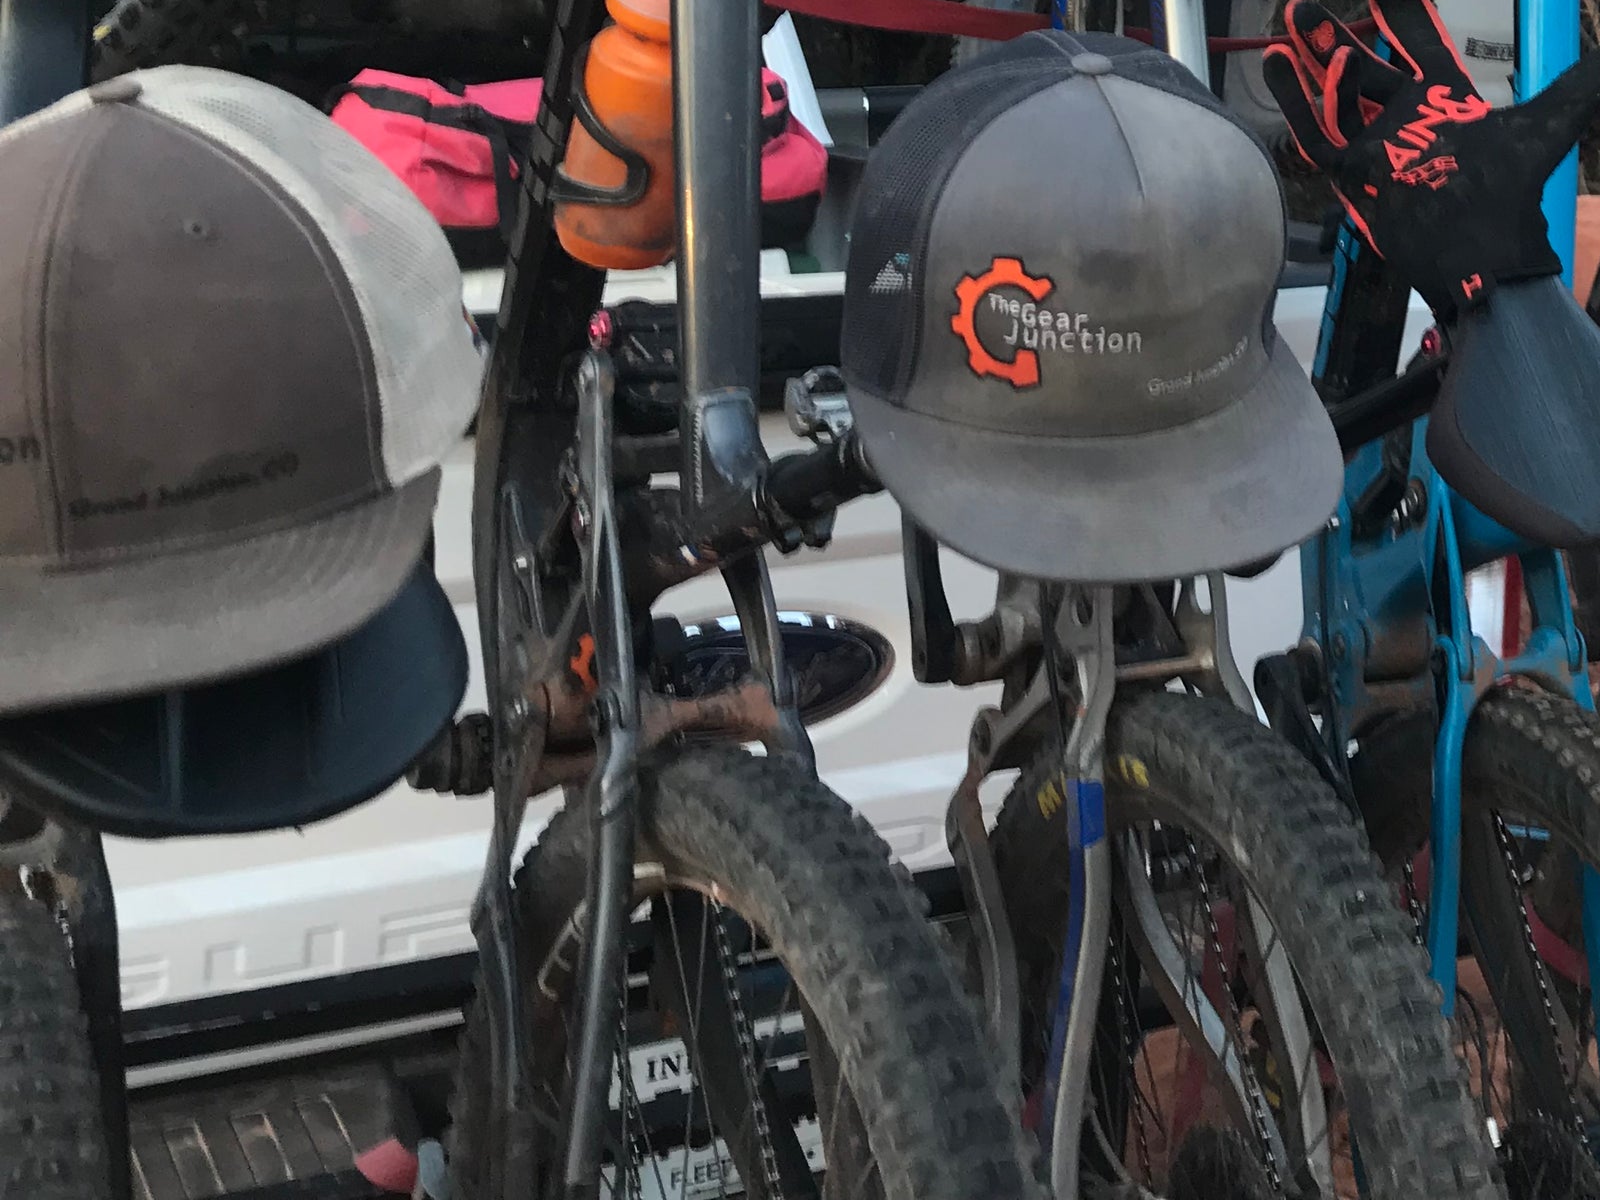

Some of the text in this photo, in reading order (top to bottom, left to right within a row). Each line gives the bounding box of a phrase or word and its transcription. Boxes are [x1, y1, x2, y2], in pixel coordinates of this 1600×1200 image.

[989, 293, 1089, 332] The Gear
[1004, 319, 1143, 354] Junction
